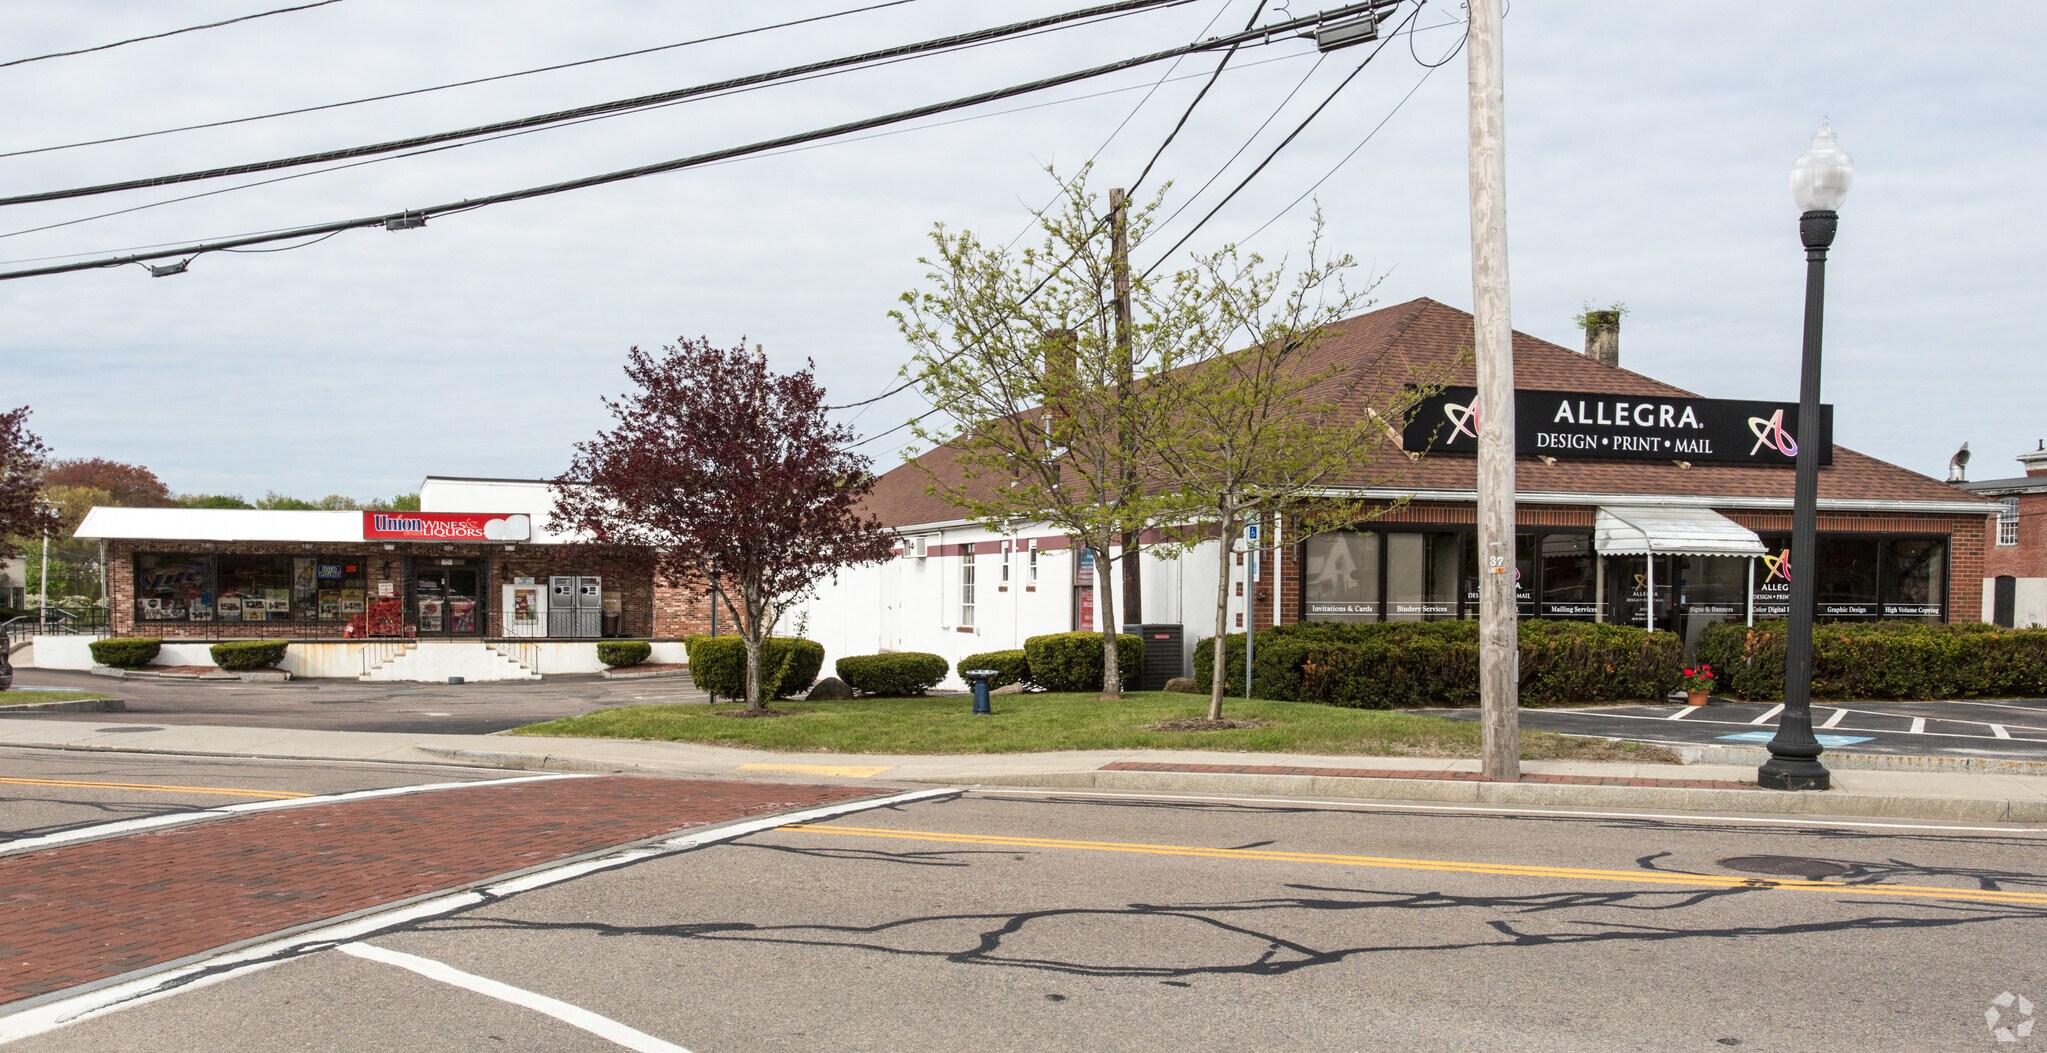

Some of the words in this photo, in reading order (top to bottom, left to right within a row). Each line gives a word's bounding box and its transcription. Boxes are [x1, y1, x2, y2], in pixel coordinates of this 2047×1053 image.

[1536, 433, 1598, 449] DESIGN
[1612, 436, 1661, 452] PRINT
[1674, 438, 1713, 454] MAIL
[374, 514, 422, 532] Union
[422, 520, 466, 529] WINES
[423, 527, 483, 537] LIQUORS
[1761, 583, 1789, 591] ALLEG
[1396, 605, 1421, 613] Bindery
[1551, 605, 1574, 614] Mailing
[1574, 605, 1598, 613] Services
[1768, 606, 1786, 614] Digital
[1884, 606, 1898, 614] High
